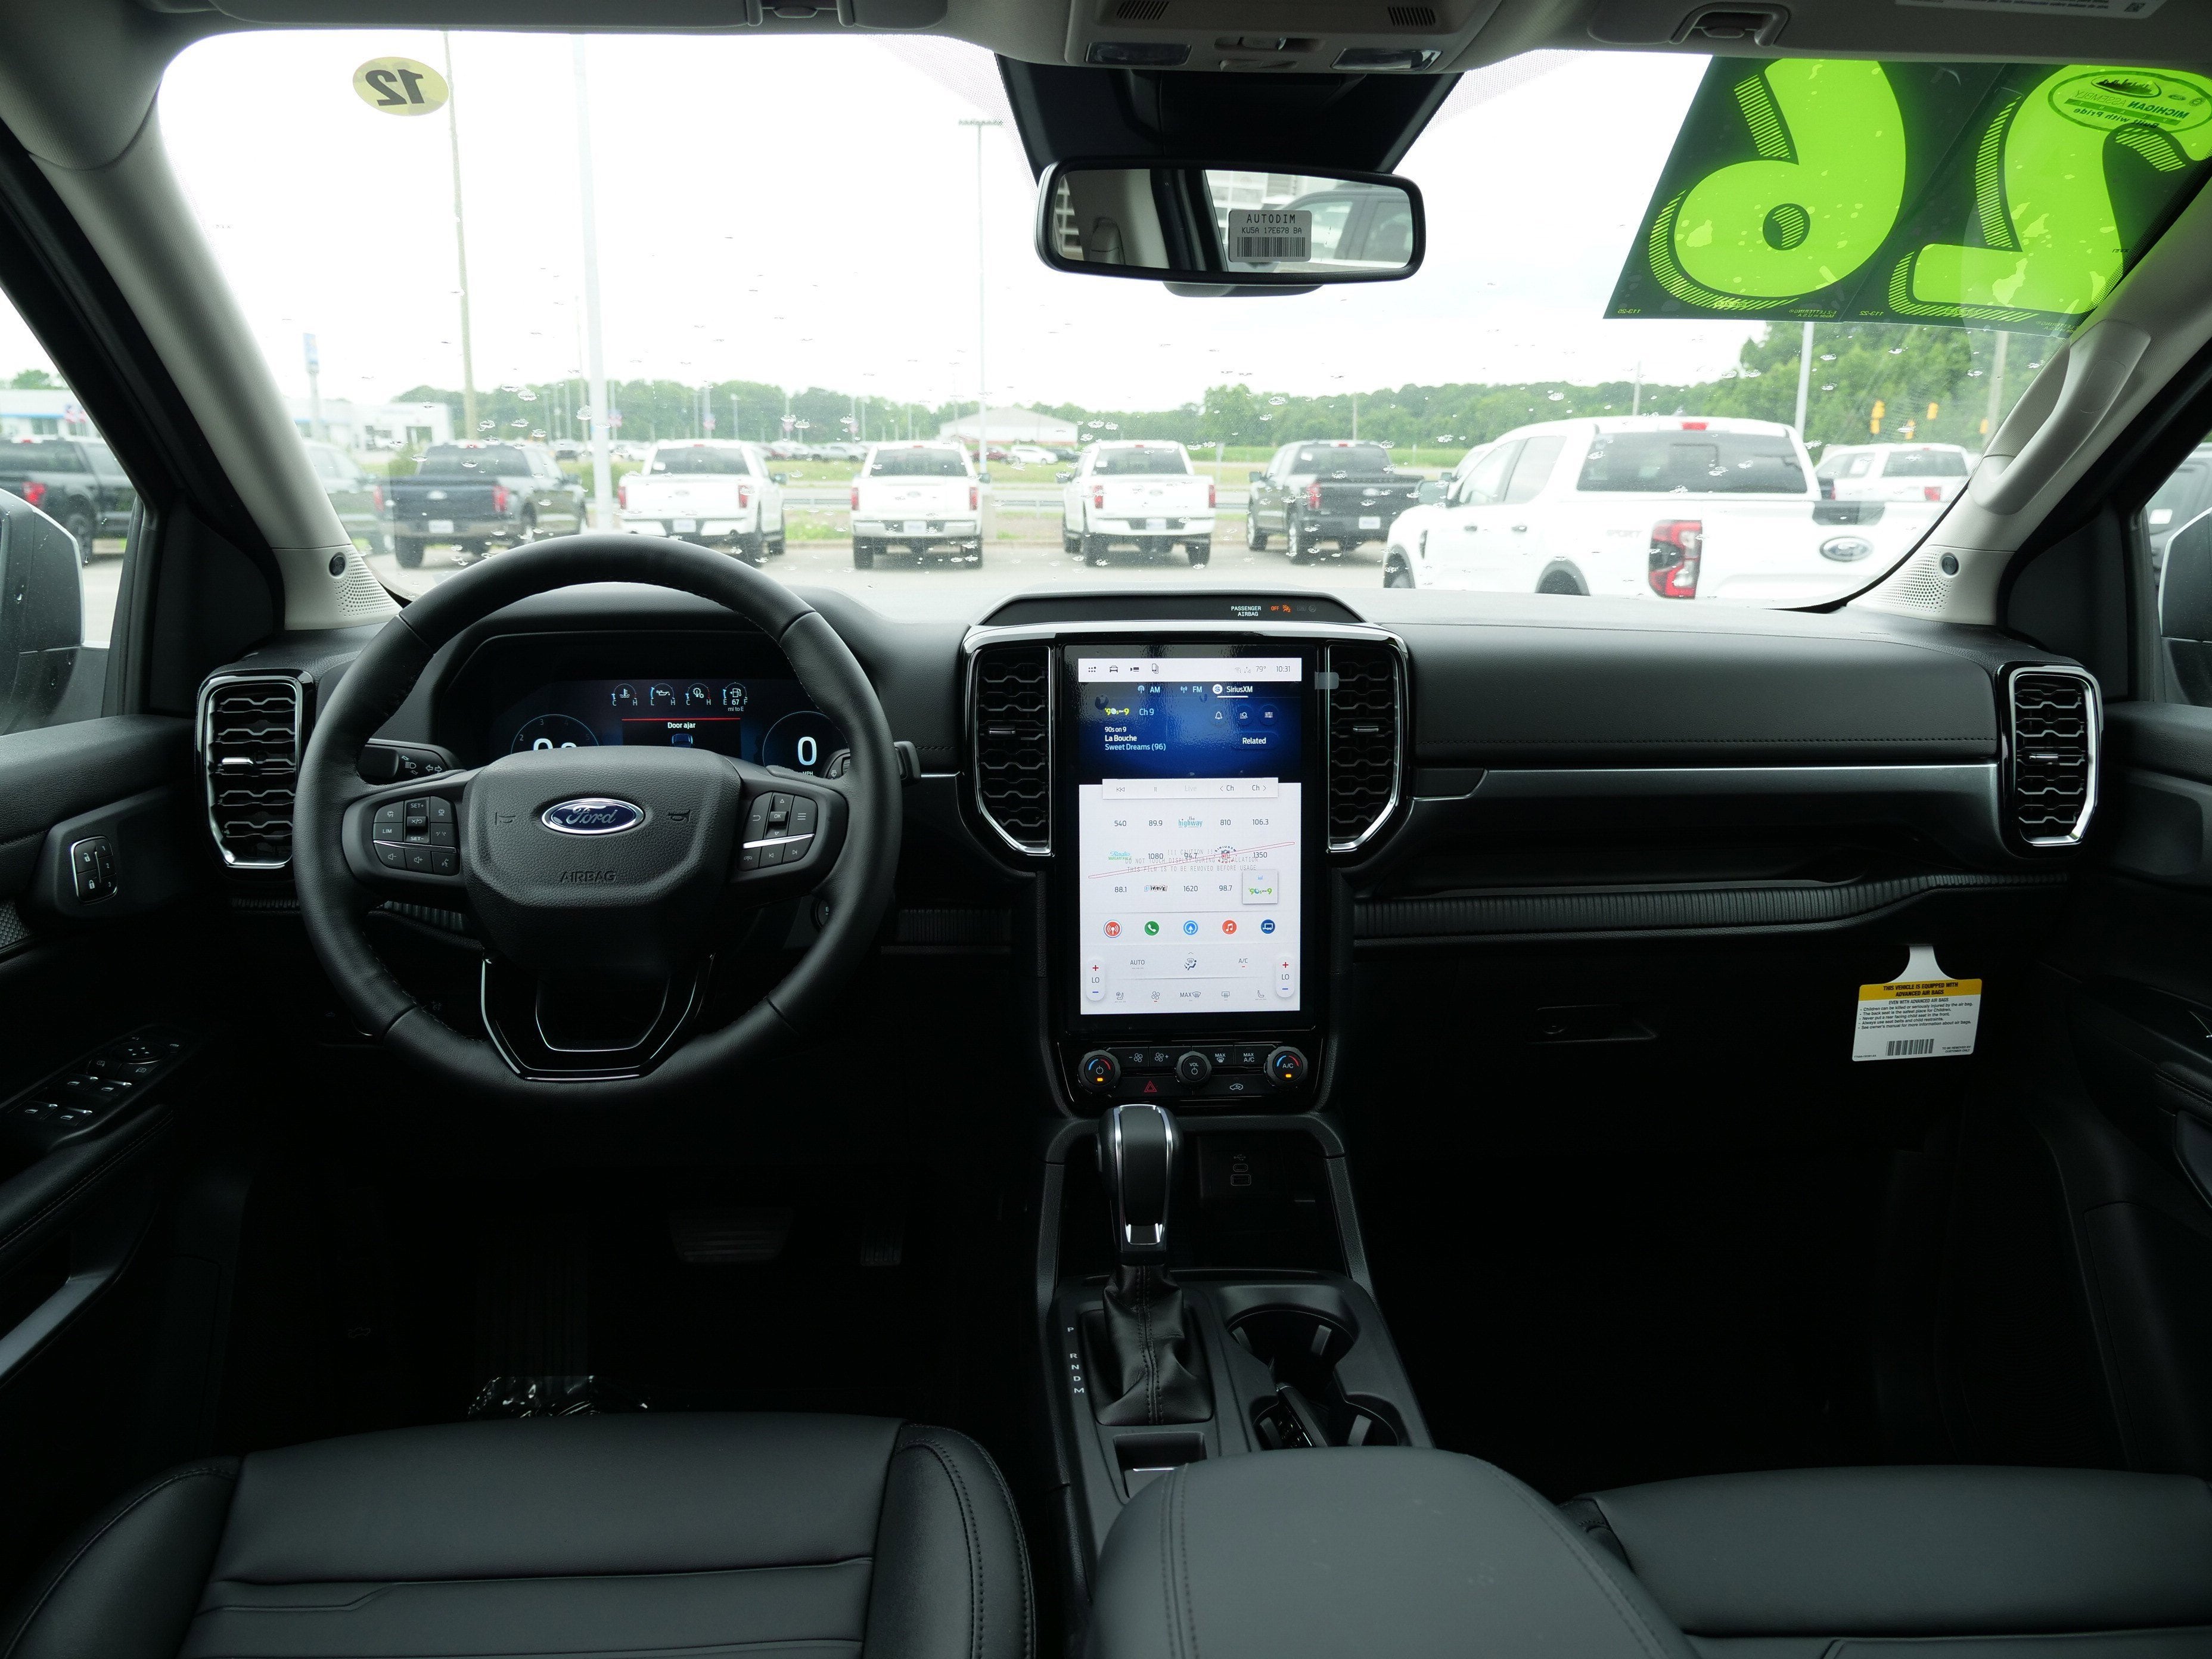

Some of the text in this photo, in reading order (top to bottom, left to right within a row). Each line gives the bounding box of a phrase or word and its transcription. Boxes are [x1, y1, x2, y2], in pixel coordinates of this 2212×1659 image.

[1247, 215, 1295, 223] AUTODIM
[797, 736, 817, 766] 0
[566, 805, 618, 824] Ford
[1179, 819, 1203, 827] highway
[560, 871, 617, 883] AIRBAG
